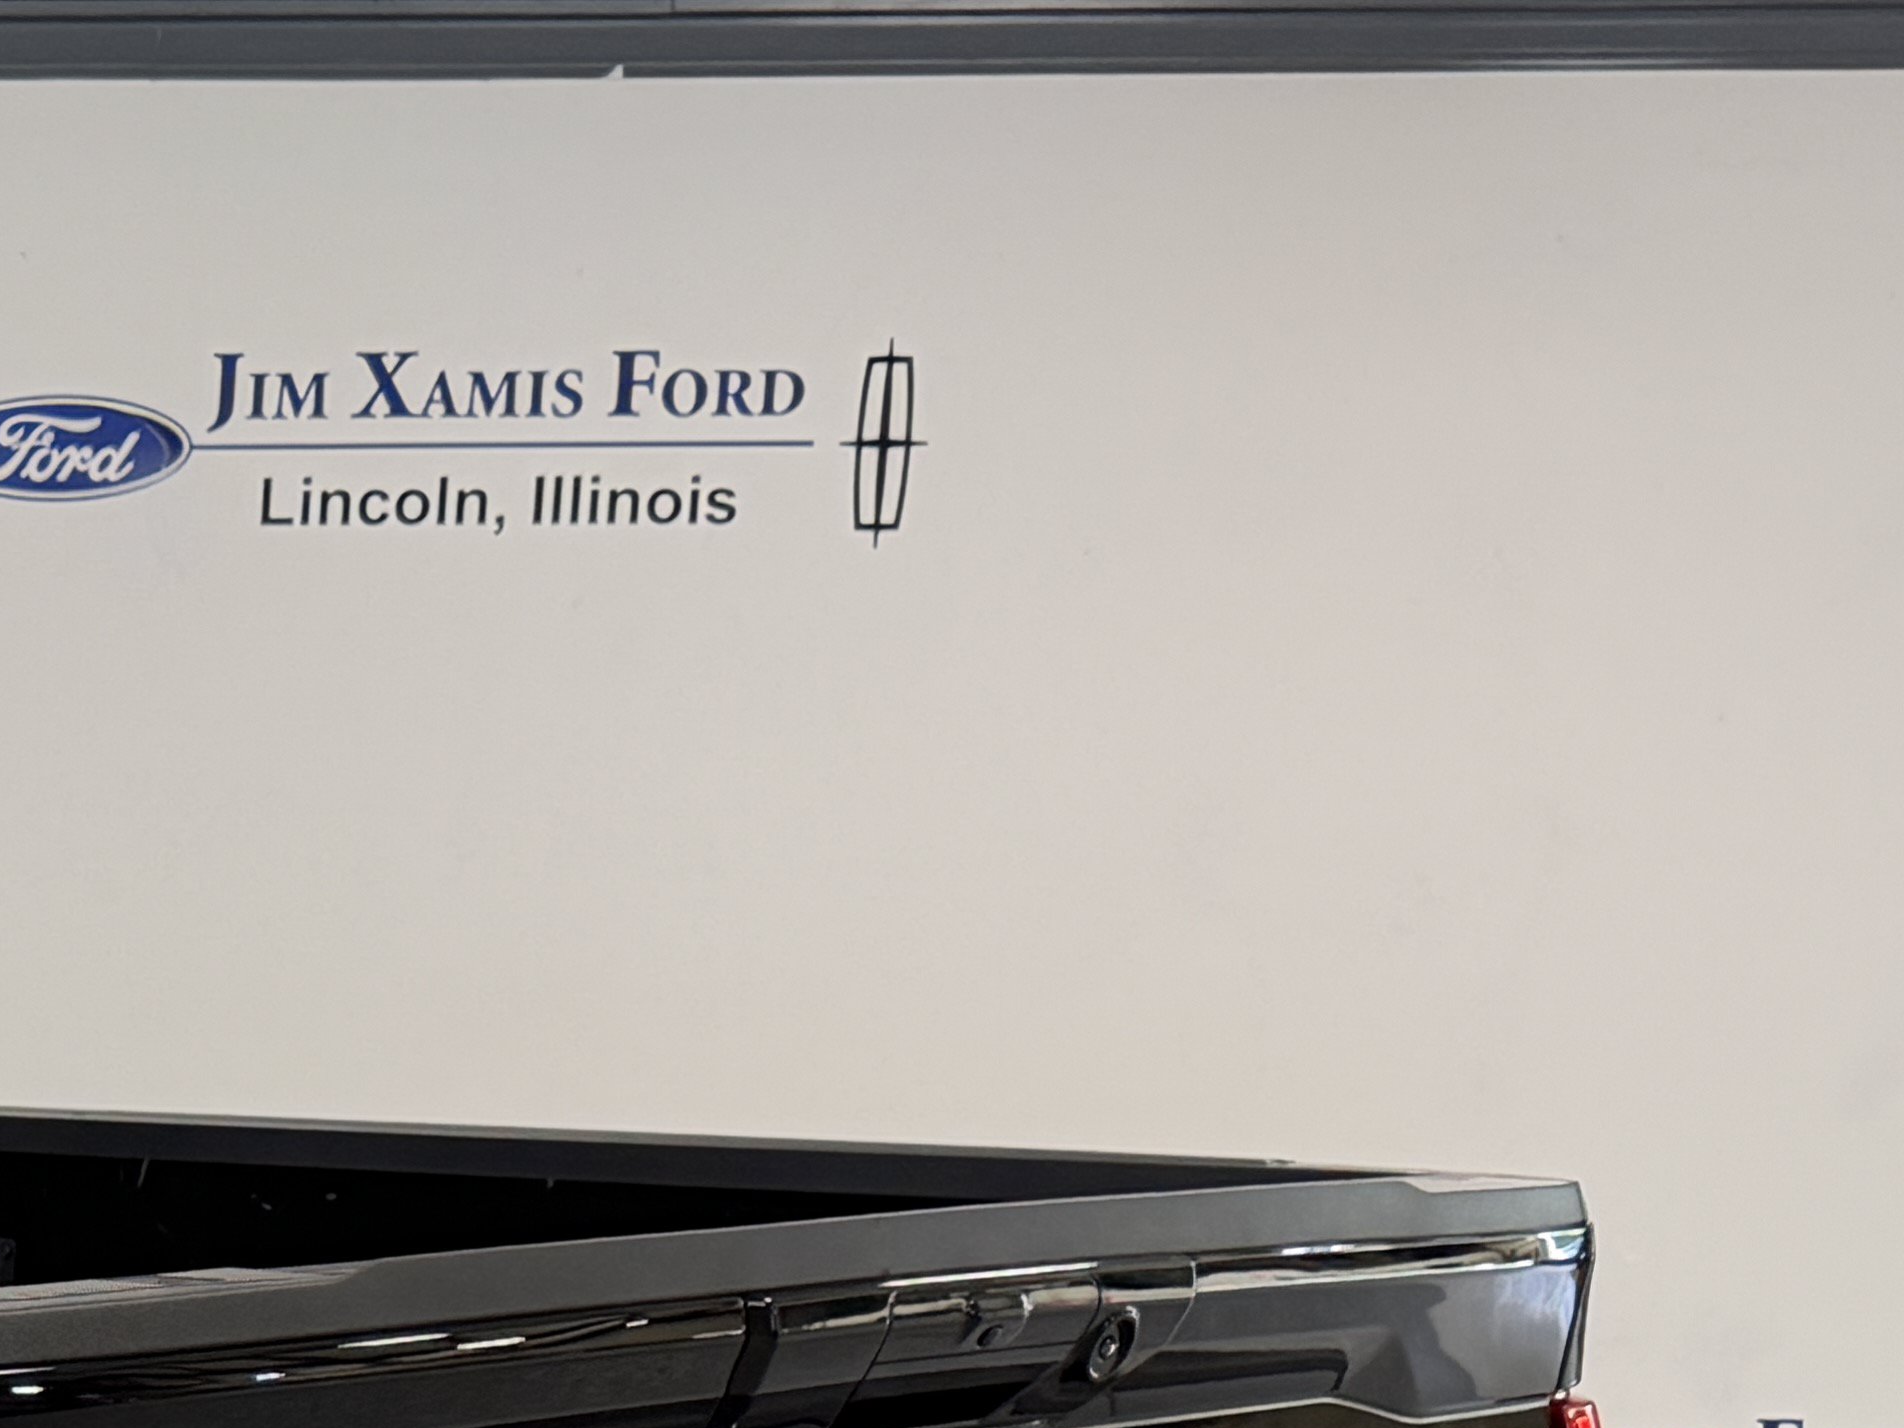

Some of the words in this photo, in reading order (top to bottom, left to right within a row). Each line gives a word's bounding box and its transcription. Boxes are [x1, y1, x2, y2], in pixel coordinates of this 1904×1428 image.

[207, 351, 328, 432] JIM
[350, 351, 586, 420] XAMIS
[606, 349, 806, 420] FORD
[260, 476, 506, 534] Lincoln,
[531, 477, 738, 527] Illinois
